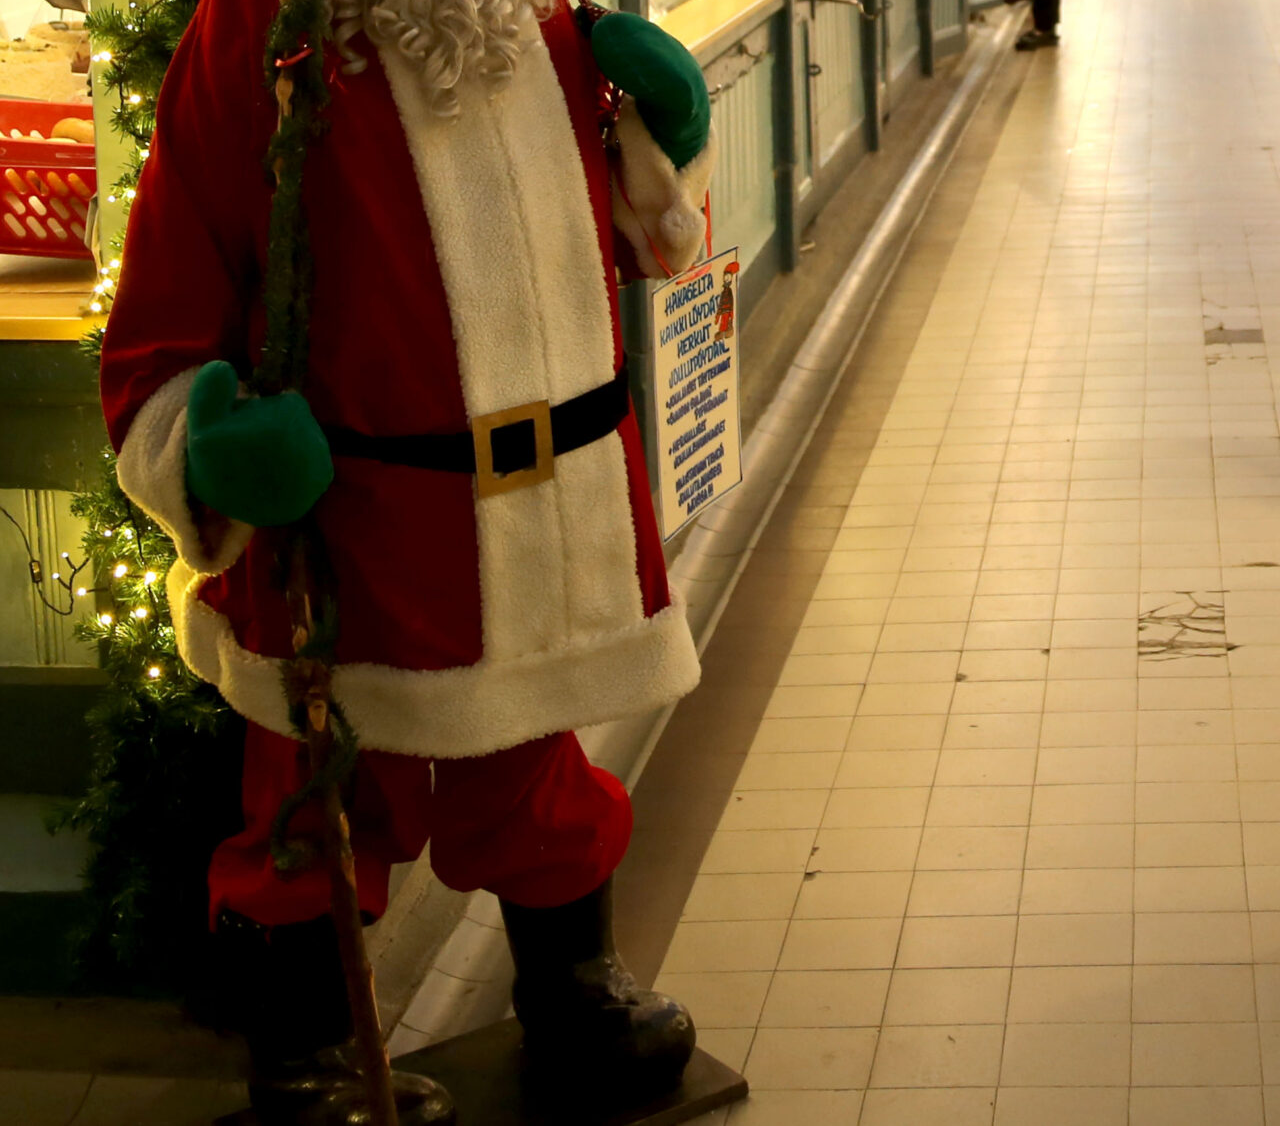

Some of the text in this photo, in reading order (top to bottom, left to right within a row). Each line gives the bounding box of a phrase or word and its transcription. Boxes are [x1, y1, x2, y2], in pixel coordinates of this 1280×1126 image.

[665, 273, 714, 317] HAKASELTA
[660, 315, 687, 347] KAIKKI
[677, 323, 712, 359] HERKUT
